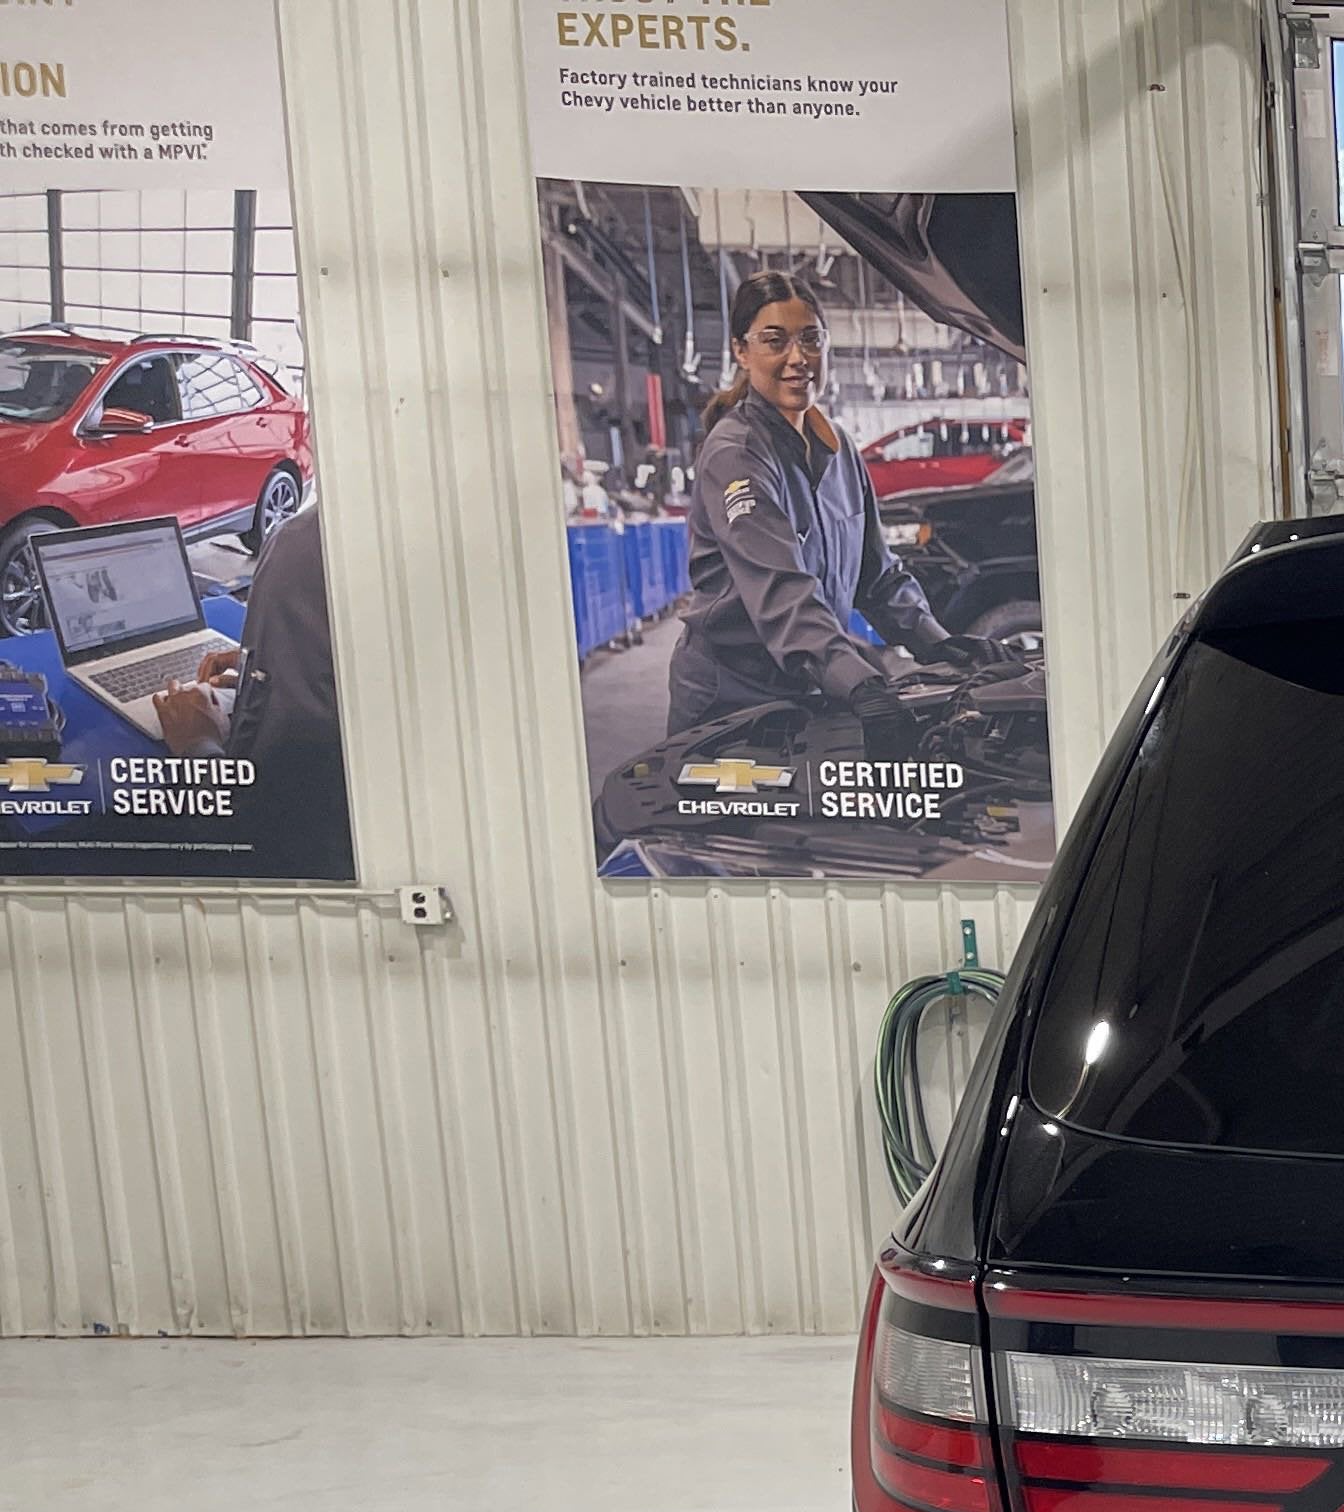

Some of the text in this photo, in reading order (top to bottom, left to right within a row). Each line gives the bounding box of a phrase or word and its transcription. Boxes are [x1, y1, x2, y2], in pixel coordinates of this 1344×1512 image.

[557, 12, 750, 52] EXPERTS.
[559, 67, 898, 96] Factory trained technicians know your
[561, 91, 860, 119] Chevy vehicle better than anyone.
[41, 123, 97, 136] comes
[103, 120, 145, 137] from
[151, 121, 213, 141] getting
[22, 143, 94, 159] checked
[99, 144, 138, 159] with
[143, 147, 153, 160] a
[110, 758, 256, 785] CERTIFIED
[819, 761, 963, 789] CERTIFIED
[113, 789, 234, 816] SERVICE
[678, 800, 800, 817] CHEVROLET
[821, 791, 941, 819] SERVICE
